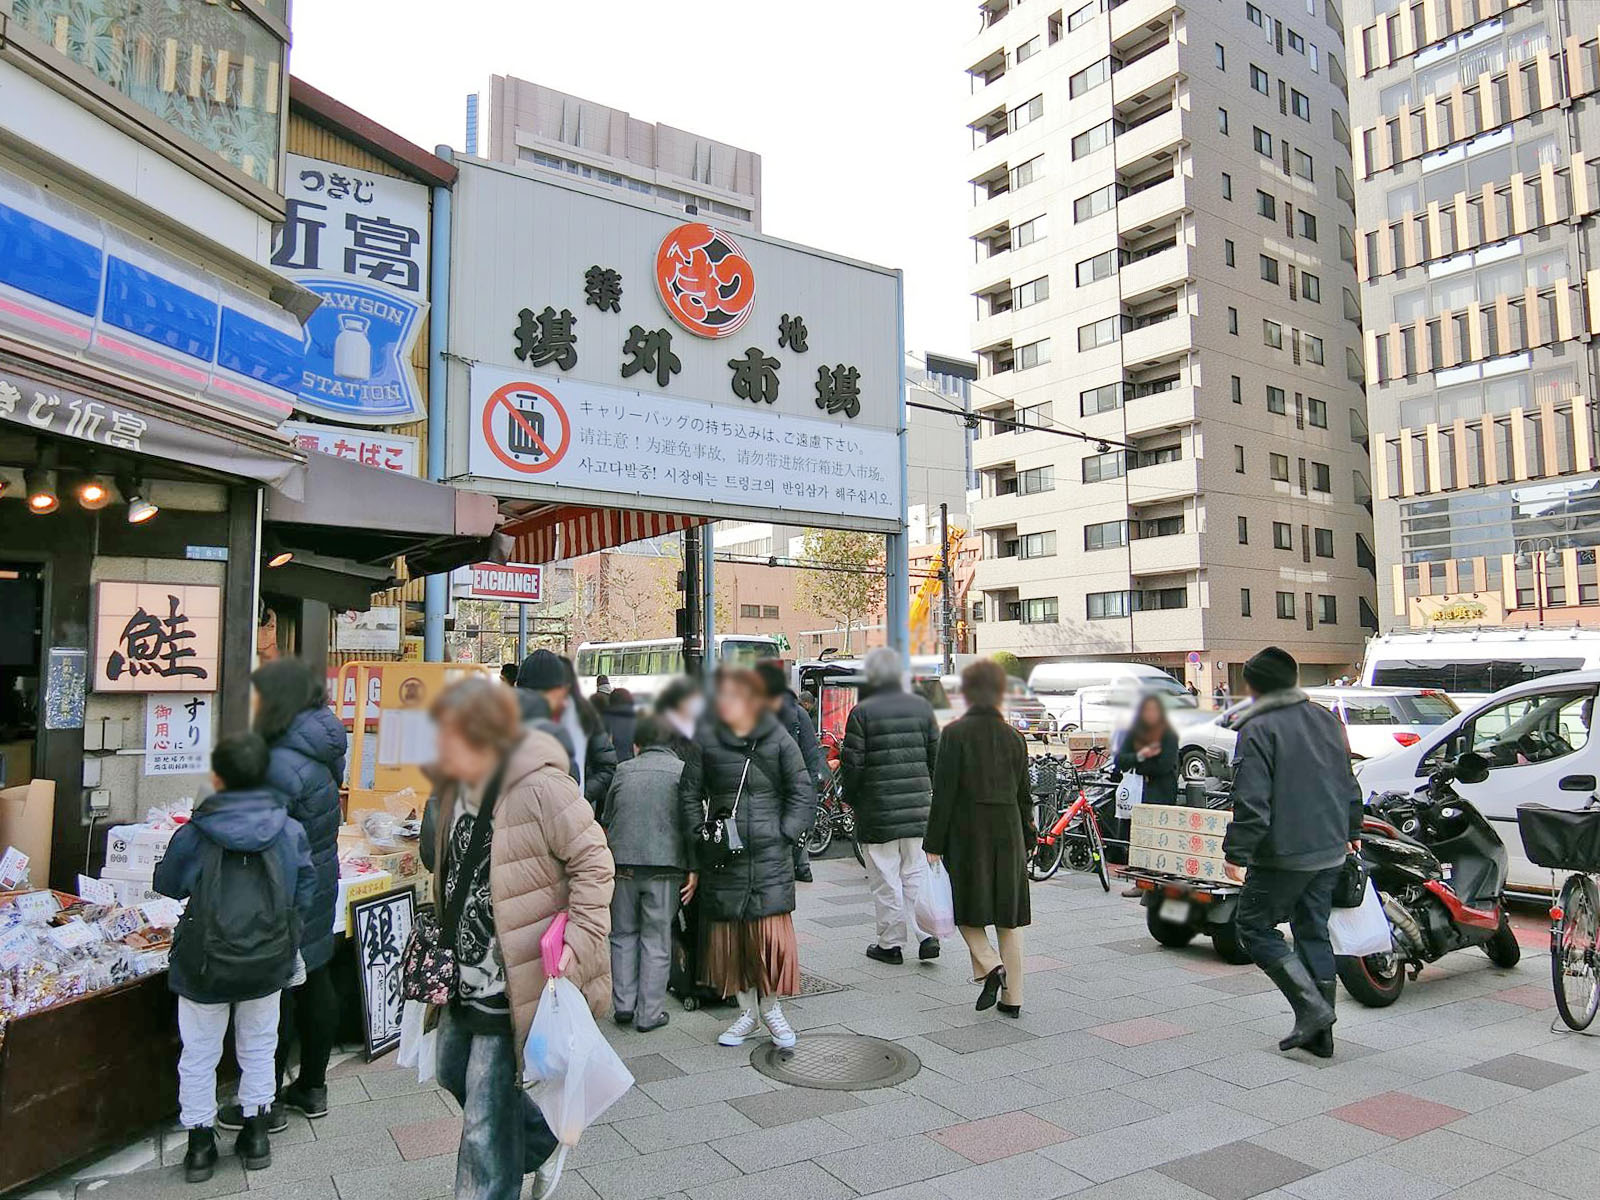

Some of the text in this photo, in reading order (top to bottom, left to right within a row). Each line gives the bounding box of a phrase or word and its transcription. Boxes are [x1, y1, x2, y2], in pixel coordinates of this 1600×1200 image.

[300, 170, 374, 204] つきじ
[321, 291, 405, 325] AWSON
[302, 371, 401, 400] STATION
[580, 401, 863, 455] キャリーバッグの持ち込みは、ご遠慮下さい。
[578, 456, 656, 480] 사고다발중!
[664, 467, 718, 487] 시장에는
[724, 475, 775, 494] 트렁크의
[835, 487, 893, 506] 해주십시오.
[473, 569, 539, 594] EXCHANGE
[106, 594, 208, 681] 鮭
[153, 704, 172, 750] 御用心
[184, 696, 205, 747] すり
